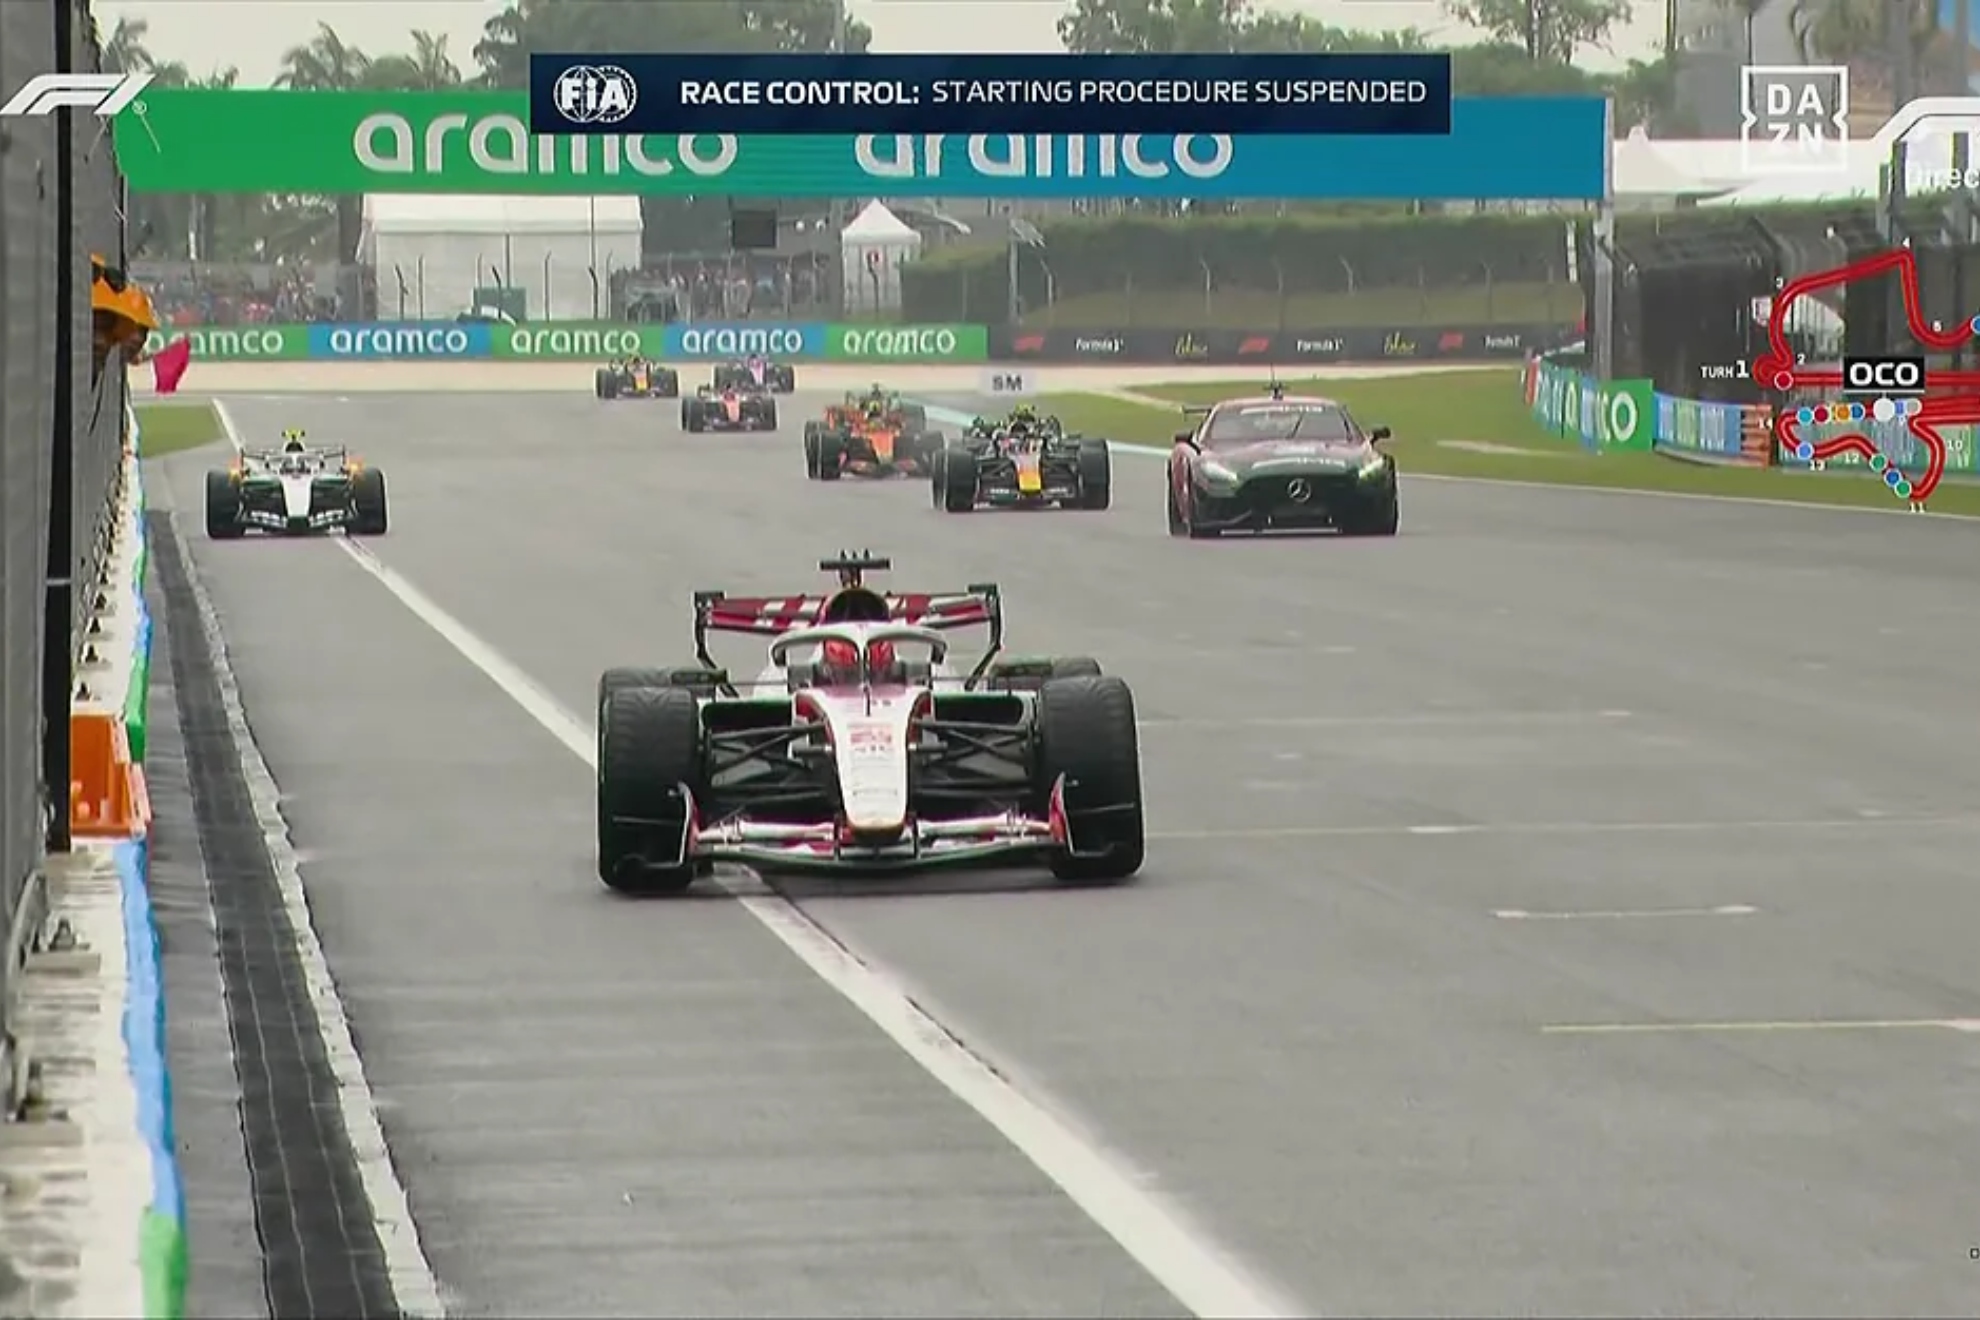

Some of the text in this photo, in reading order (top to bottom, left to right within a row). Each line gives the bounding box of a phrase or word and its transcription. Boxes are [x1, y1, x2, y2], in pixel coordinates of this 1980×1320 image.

[353, 112, 738, 175] aramco
[853, 132, 1233, 177] aramco
[330, 328, 468, 354] aramco
[511, 328, 641, 354] aramco
[682, 328, 802, 354] aramco
[843, 328, 956, 355] aramco
